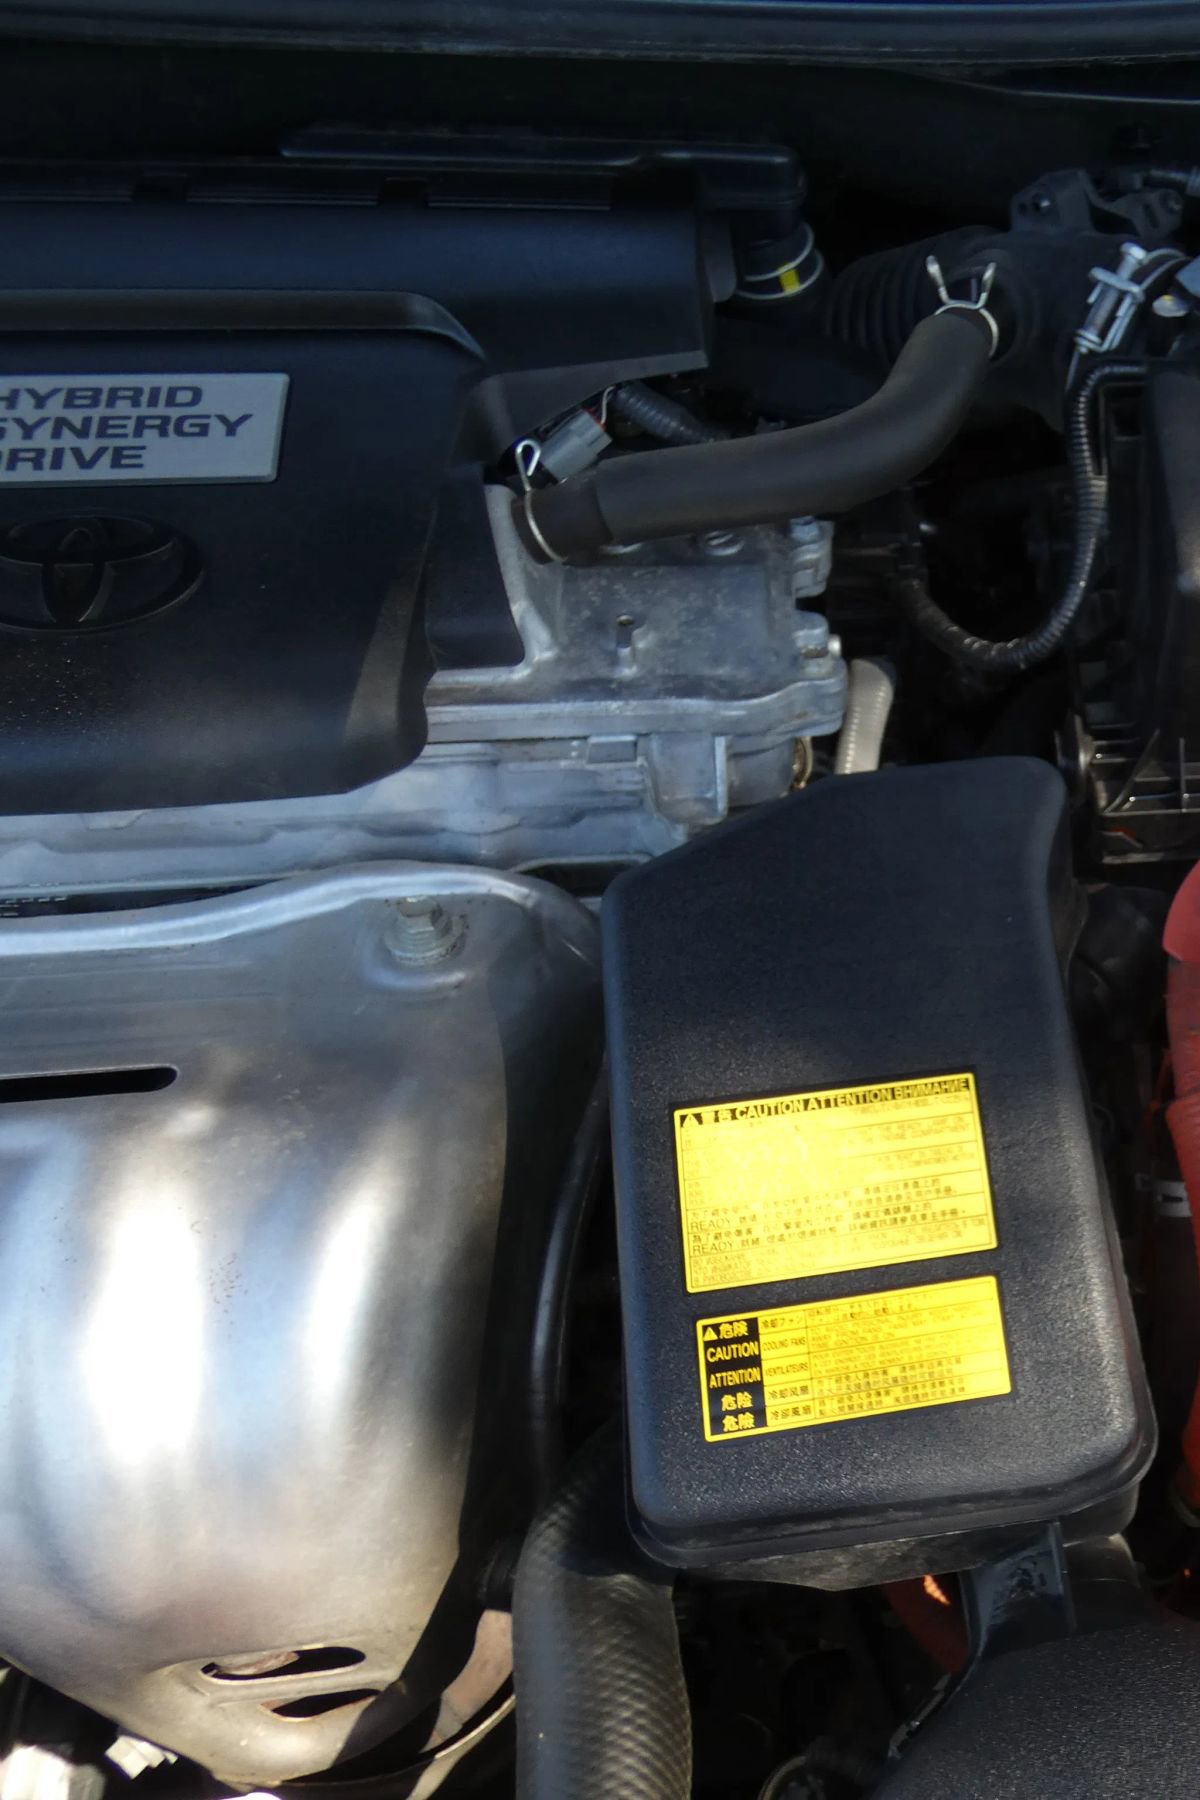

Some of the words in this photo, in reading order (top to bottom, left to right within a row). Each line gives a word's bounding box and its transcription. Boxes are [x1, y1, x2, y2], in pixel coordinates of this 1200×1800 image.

[0, 414, 253, 440] YNERGY
[0, 445, 147, 471] RIVE
[735, 1100, 803, 1120] CAUTION
[807, 1088, 891, 1110] ATTENTION
[690, 1216, 731, 1232] READY
[691, 1239, 733, 1255] READY
[706, 1340, 758, 1363] CAUTION
[708, 1366, 761, 1388] ATTENTION
